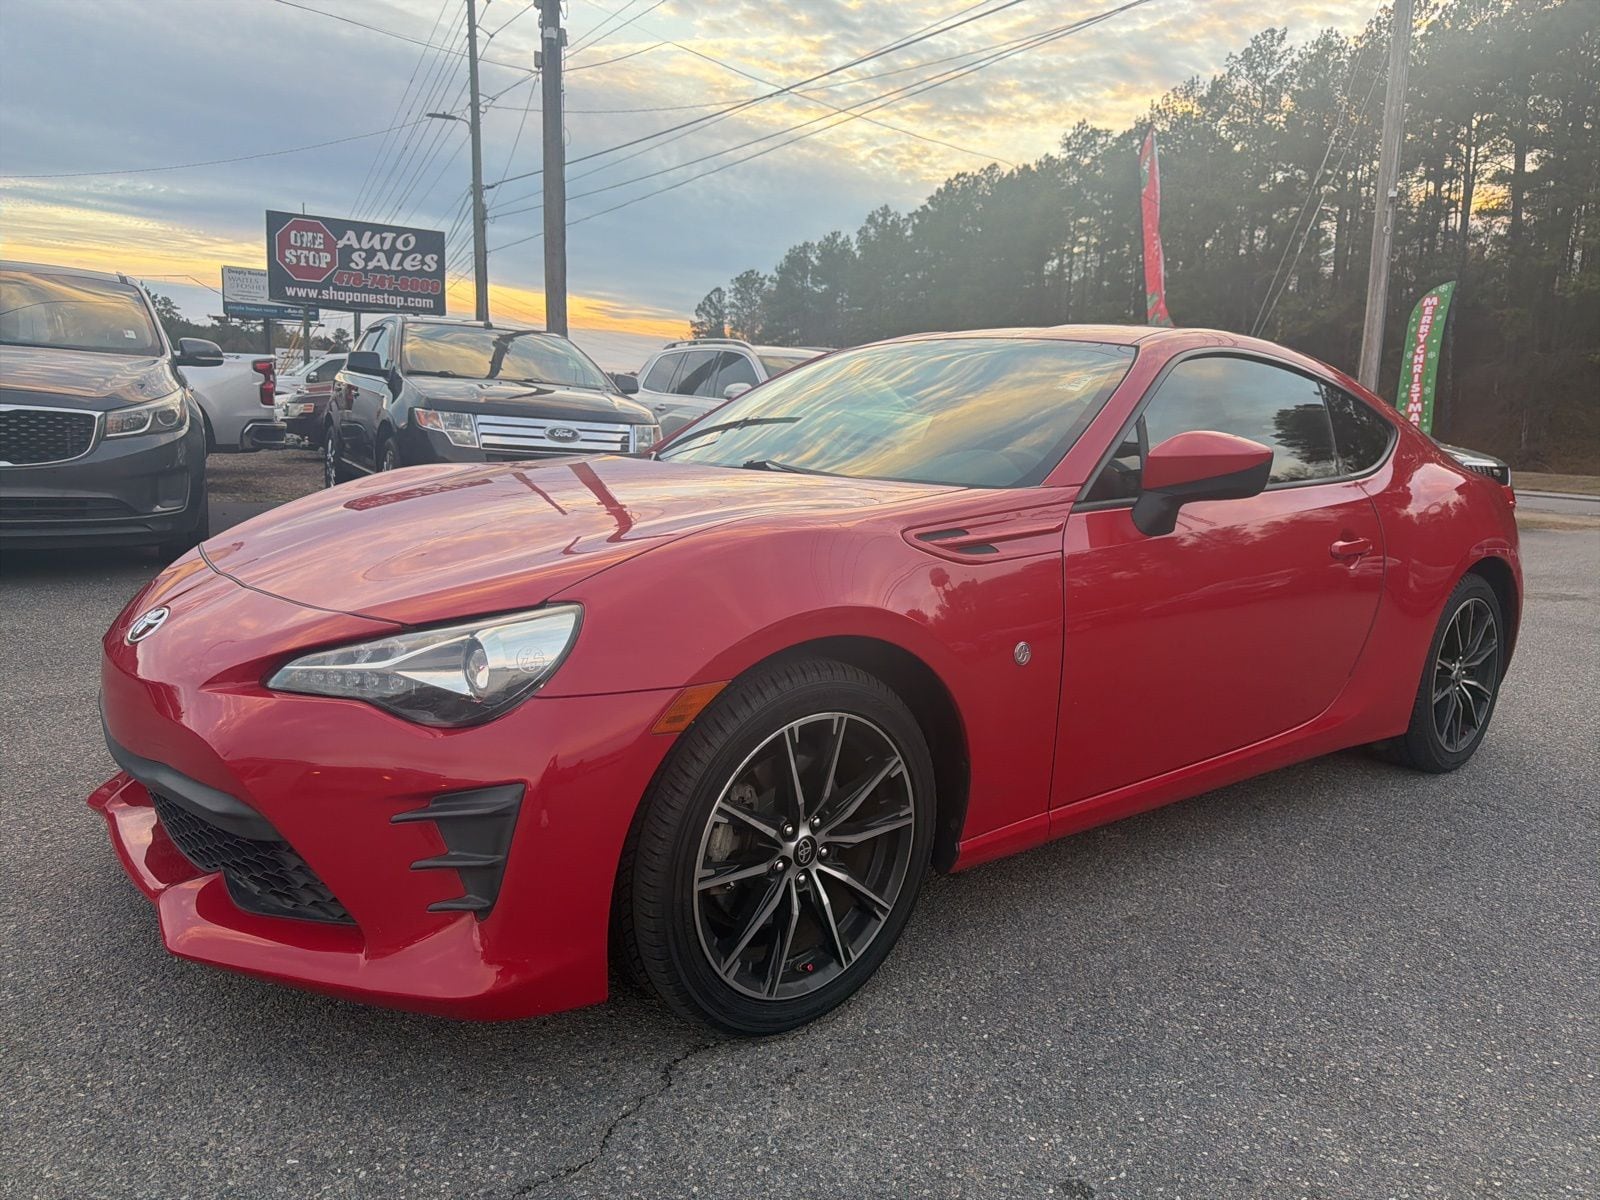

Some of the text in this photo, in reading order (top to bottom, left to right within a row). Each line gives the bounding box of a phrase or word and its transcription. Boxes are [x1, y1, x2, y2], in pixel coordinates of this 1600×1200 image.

[290, 230, 324, 249] ONE
[284, 248, 331, 268] STOP
[332, 270, 441, 294] 478-741-8009
[285, 286, 434, 309] www.shoponestop.com
[1417, 296, 1438, 343] MERRY
[554, 428, 573, 438] Ford
